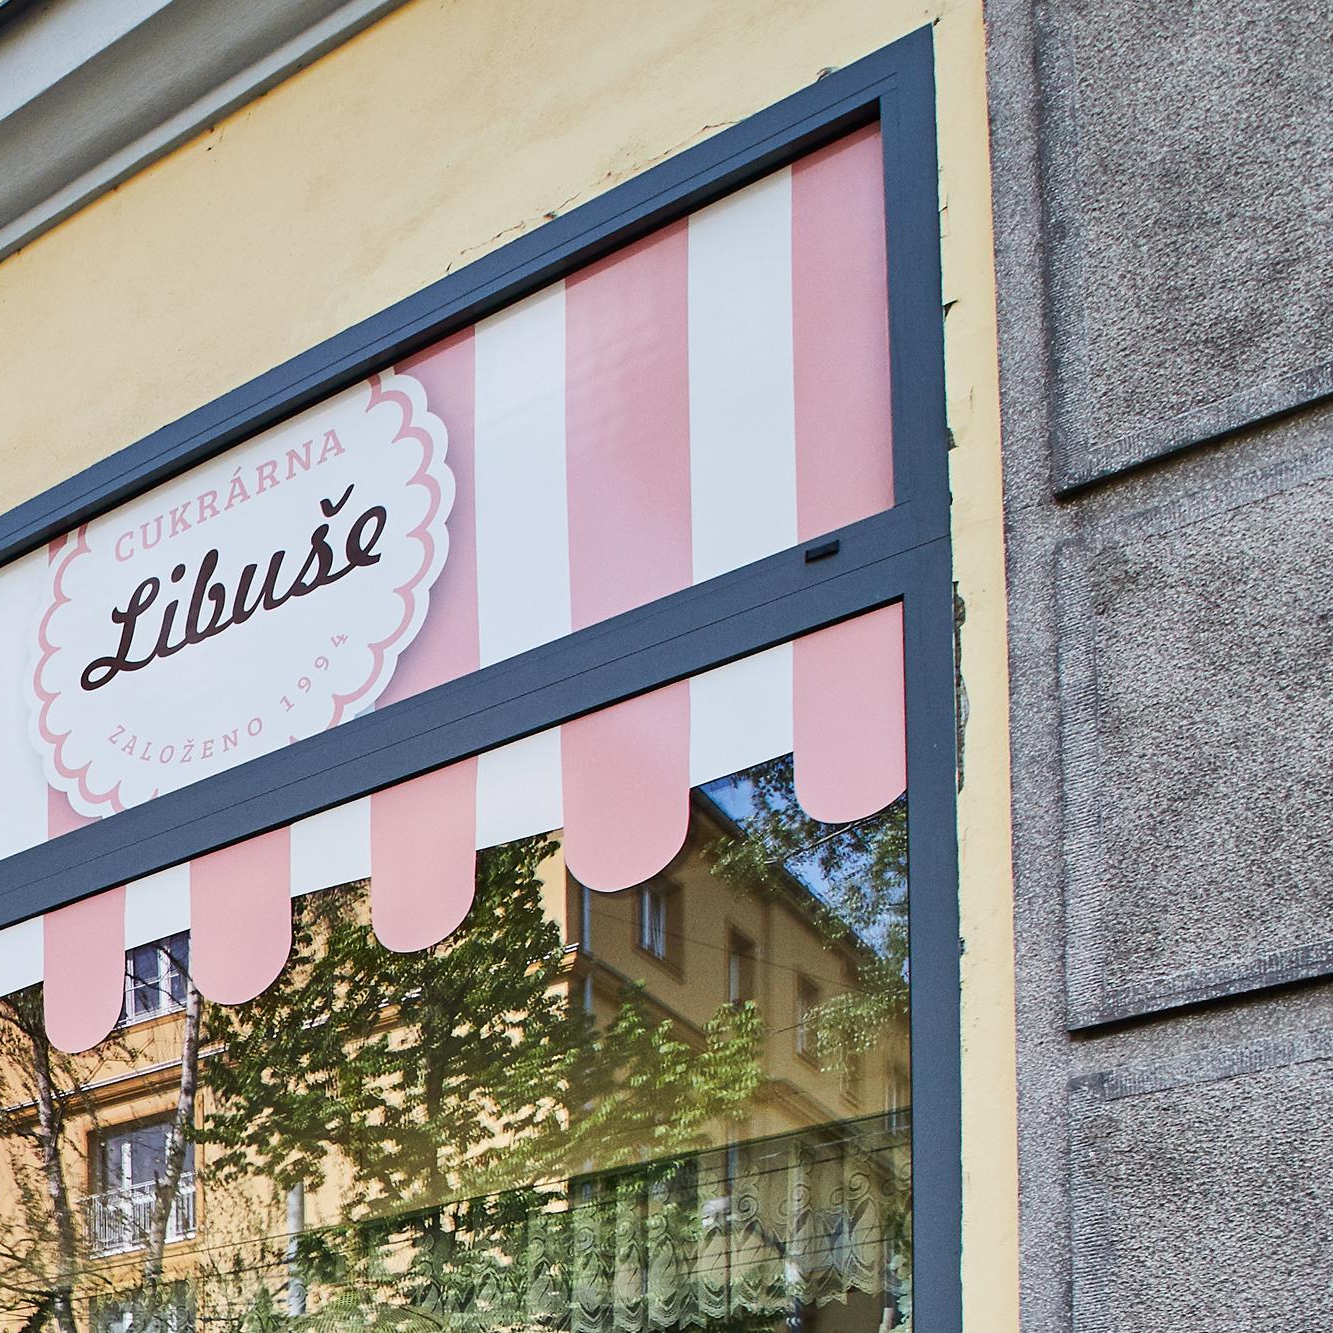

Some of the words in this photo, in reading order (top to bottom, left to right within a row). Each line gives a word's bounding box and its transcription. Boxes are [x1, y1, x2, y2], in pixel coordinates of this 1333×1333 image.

[114, 428, 346, 563] CUKRÁRNA
[80, 484, 388, 691] Libuše
[107, 717, 265, 765] ZALOŽENO
[279, 631, 350, 713] 1994
